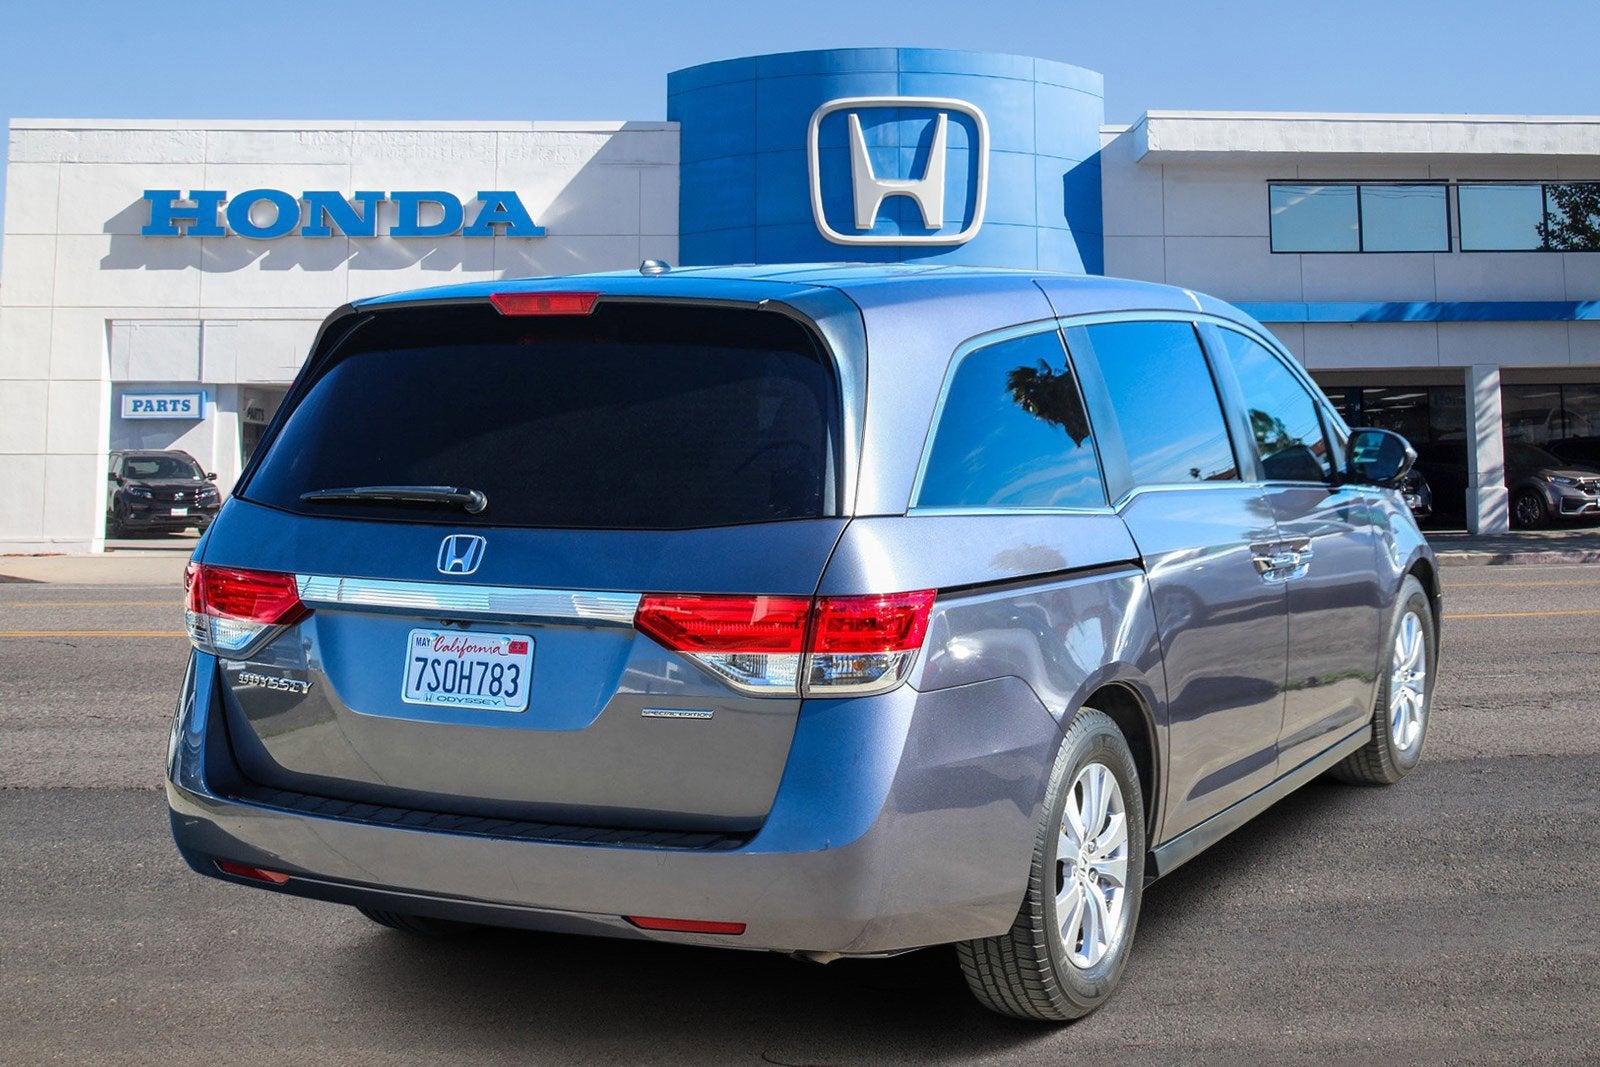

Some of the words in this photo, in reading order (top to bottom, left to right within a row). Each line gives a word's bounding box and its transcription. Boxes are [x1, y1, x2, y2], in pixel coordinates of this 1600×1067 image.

[140, 188, 548, 239] HONDA
[131, 399, 191, 413] PARTS
[415, 637, 431, 647] MAY
[433, 635, 508, 659] California
[415, 656, 520, 698] 7SOH783
[436, 695, 501, 706] ODYSSEY
